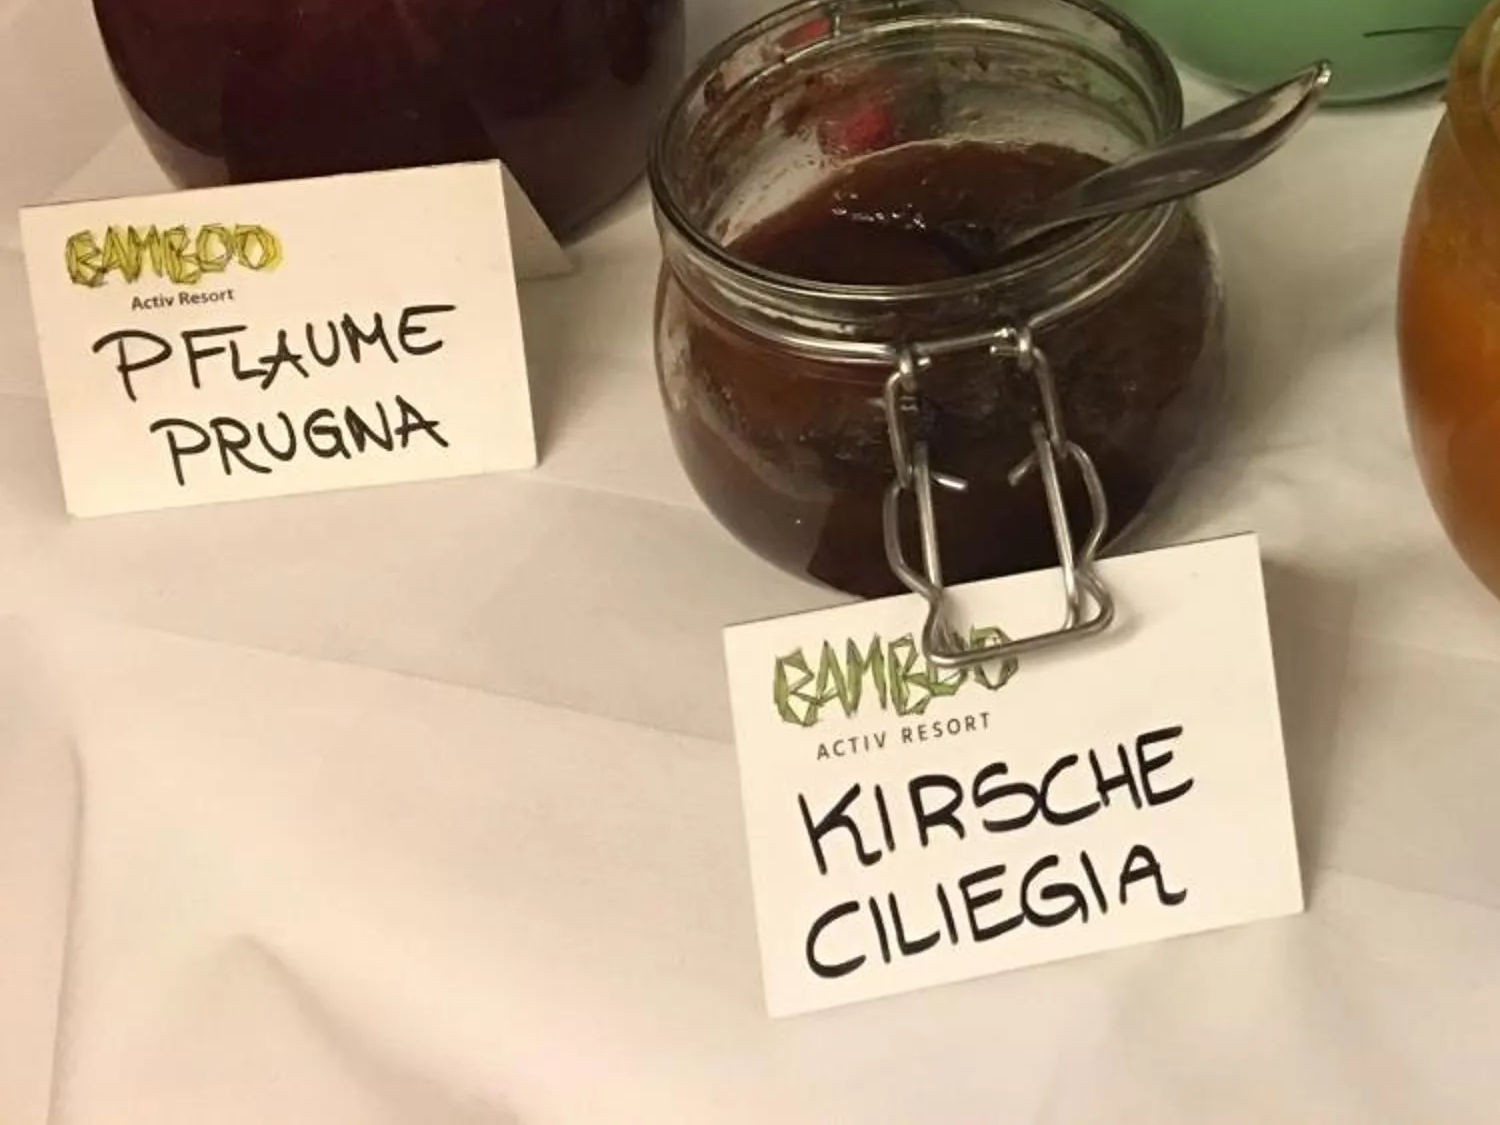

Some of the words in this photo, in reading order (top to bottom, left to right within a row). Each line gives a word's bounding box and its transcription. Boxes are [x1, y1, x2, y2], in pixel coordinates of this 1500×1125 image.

[65, 223, 282, 288] BAMBOO
[131, 292, 175, 311] Activ
[179, 288, 235, 306] Resort
[92, 303, 456, 402] PFLAUME
[150, 395, 449, 486] PRUGNA
[816, 730, 887, 760] ACTIV
[901, 711, 991, 743] RESORT
[798, 725, 1194, 875] KIRSCHE
[805, 844, 1187, 978] CILIEGIA
